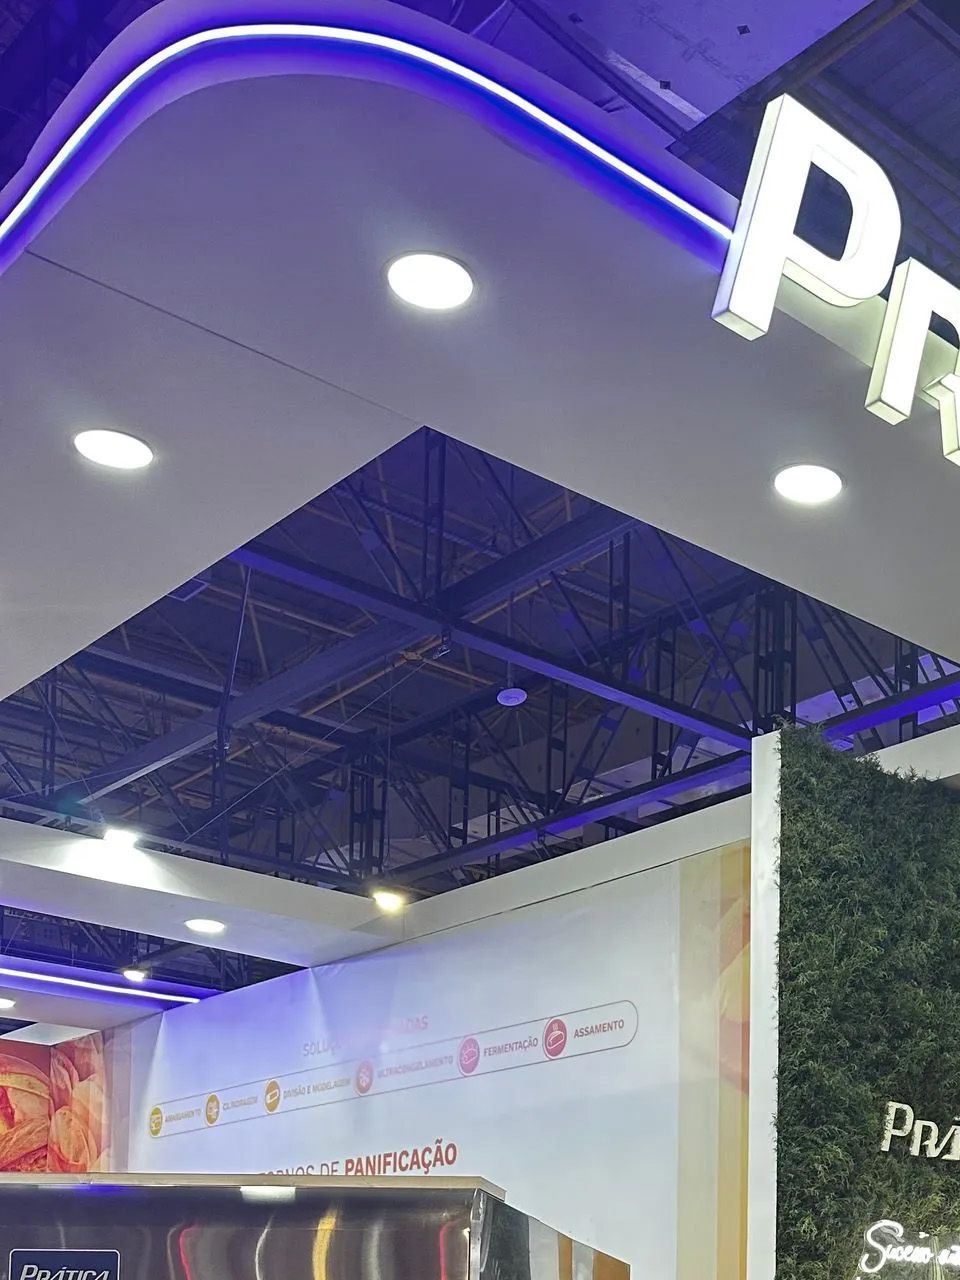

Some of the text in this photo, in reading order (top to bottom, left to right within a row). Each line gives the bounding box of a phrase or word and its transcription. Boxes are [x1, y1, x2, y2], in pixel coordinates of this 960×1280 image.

[573, 1019, 625, 1039] ASSAMENTO
[483, 1036, 539, 1057] FERMENTAÇÃO
[306, 1085, 311, 1095] E
[344, 1138, 458, 1176] PANIFICAÇÃO
